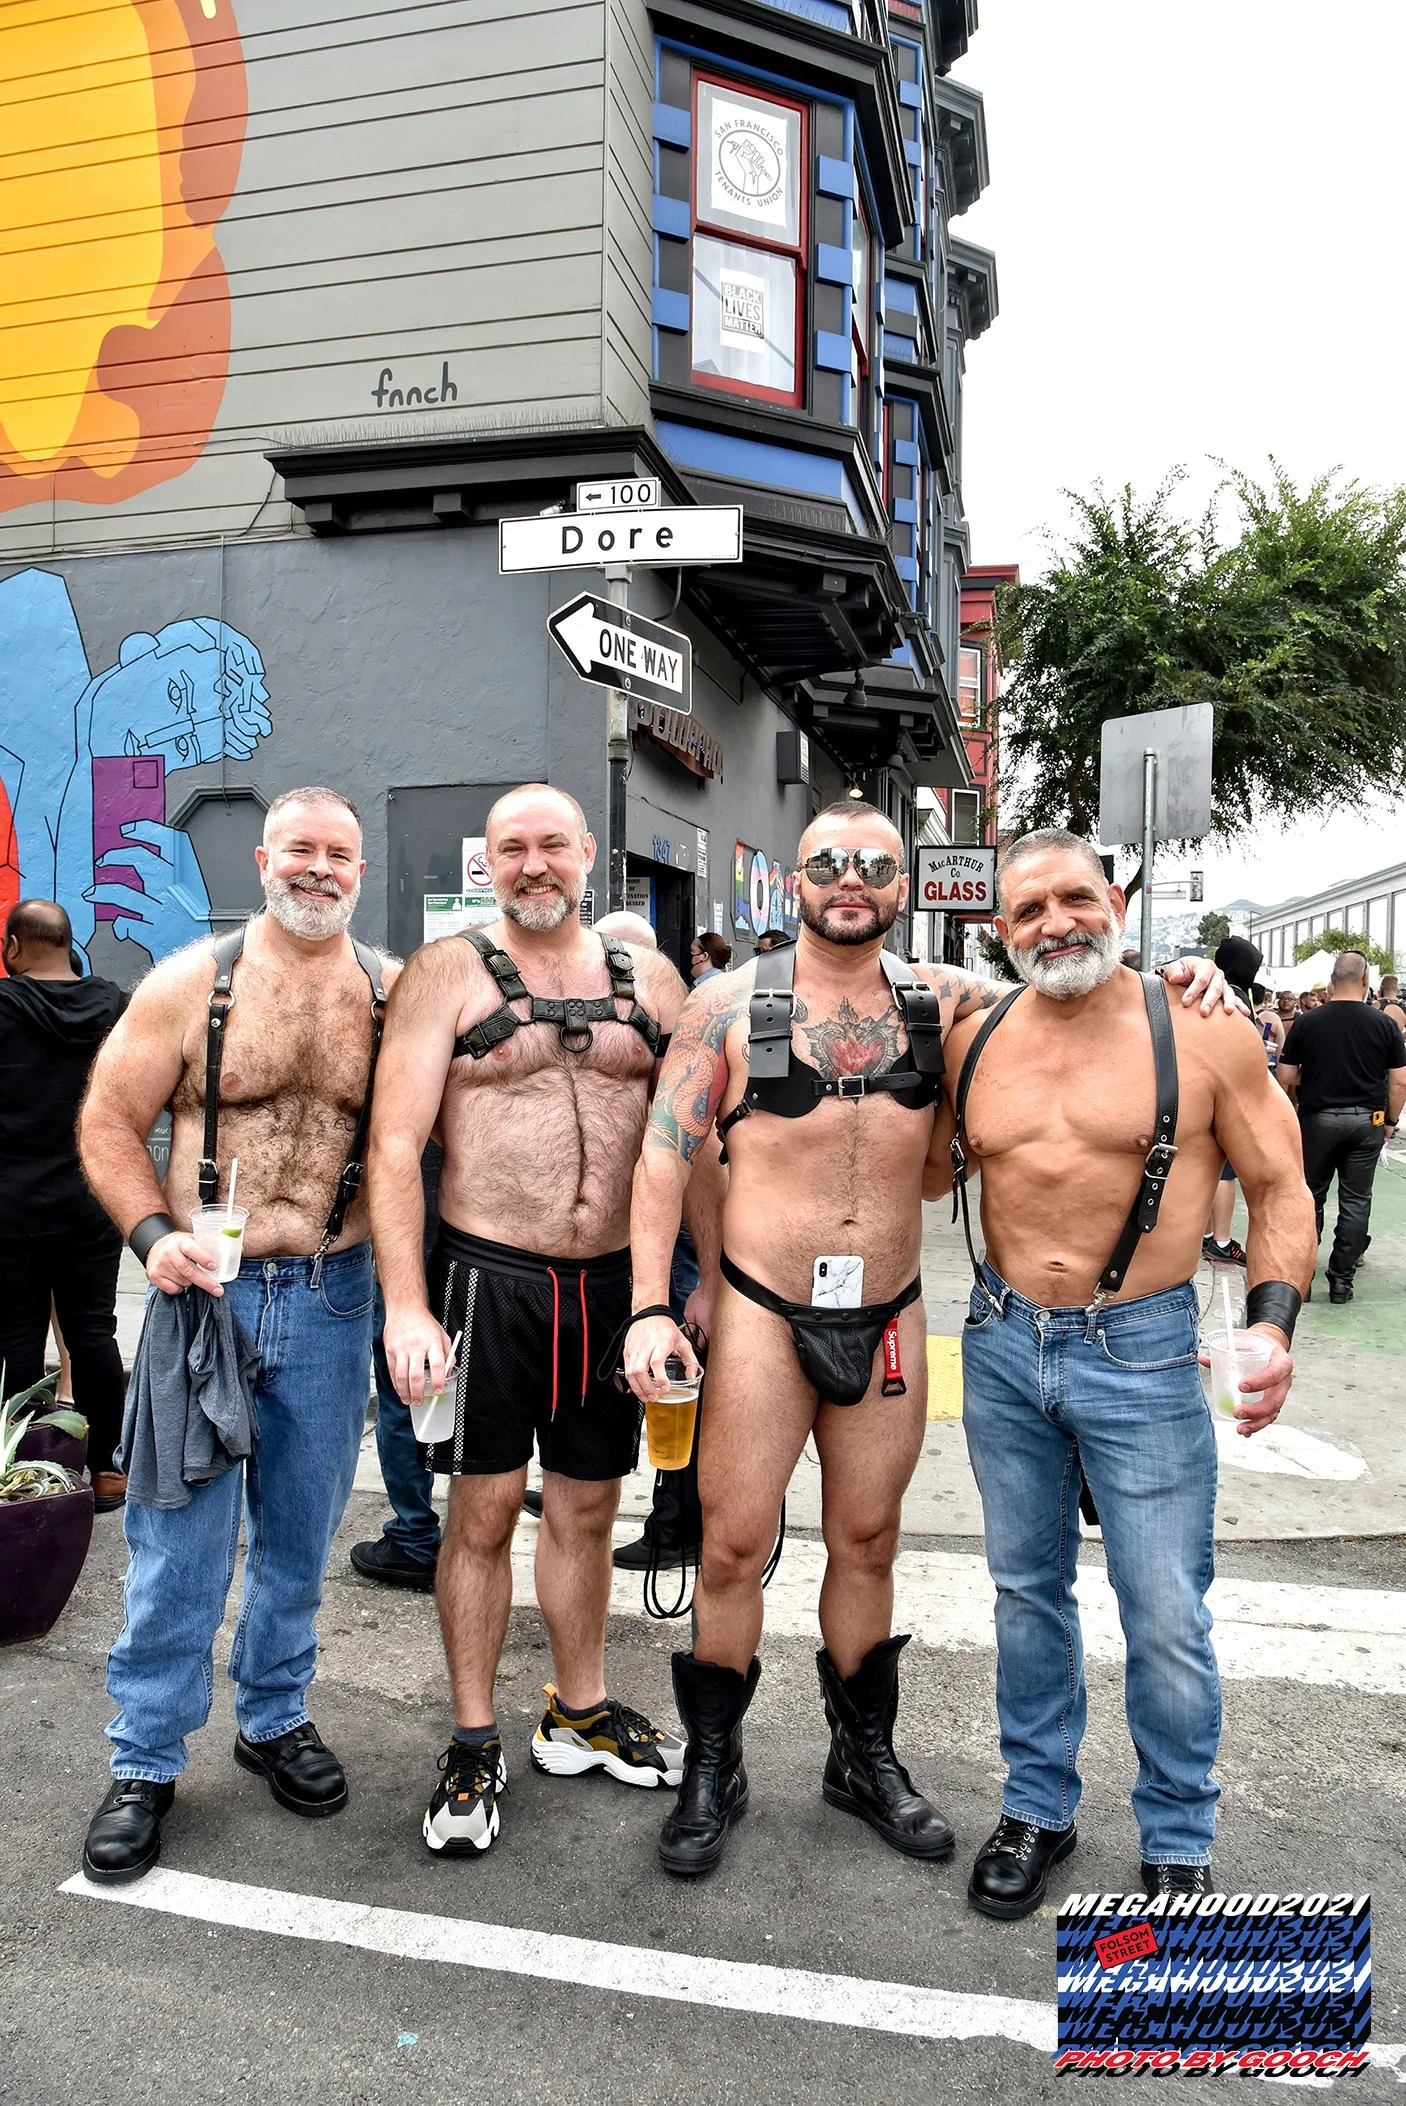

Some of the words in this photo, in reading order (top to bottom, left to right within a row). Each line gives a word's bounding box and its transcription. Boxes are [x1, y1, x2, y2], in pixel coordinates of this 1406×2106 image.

[715, 121, 731, 138] SAN
[734, 119, 784, 156] FRANCISCO
[715, 170, 751, 206] TENANTS
[756, 187, 784, 207] UNION
[724, 283, 761, 304] BLACK
[725, 298, 761, 321] LIVES
[724, 315, 762, 335] MATTER
[371, 361, 458, 408] fnnch
[610, 483, 651, 505] 100
[561, 525, 674, 555] Dore
[599, 628, 637, 669] ONE
[643, 645, 678, 684] WAY
[924, 880, 987, 901] GLASS
[887, 1331, 897, 1370] Supreme
